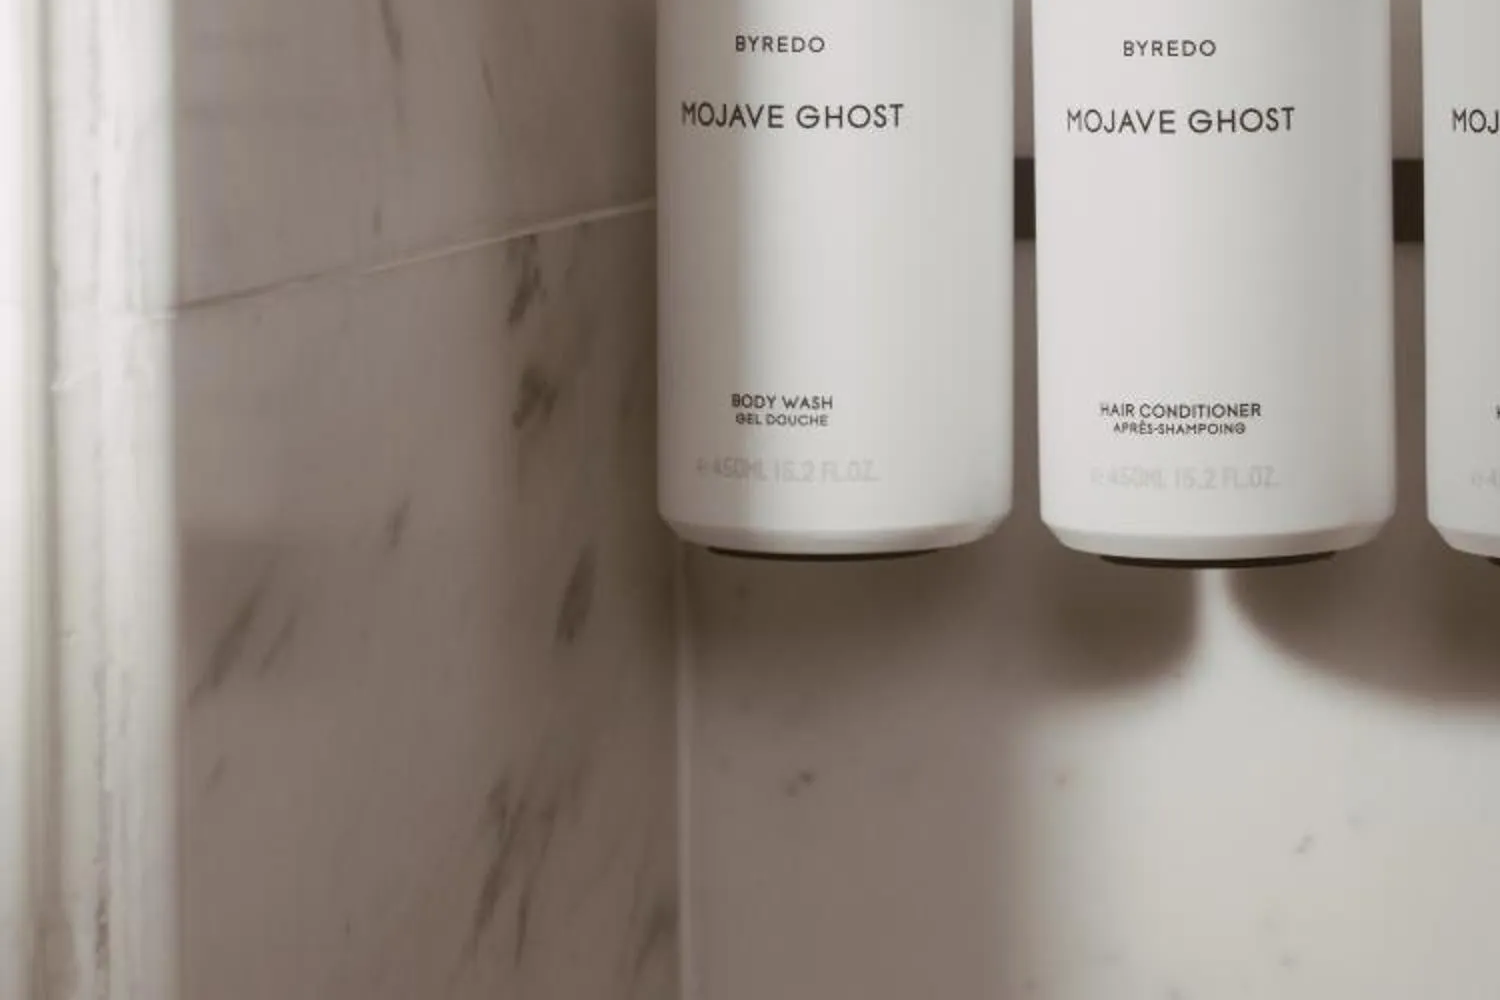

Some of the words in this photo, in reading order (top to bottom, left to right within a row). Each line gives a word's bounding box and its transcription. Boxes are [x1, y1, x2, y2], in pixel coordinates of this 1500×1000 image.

[735, 34, 826, 54] BYREDO
[1123, 39, 1217, 57] BYREDO
[681, 101, 785, 130] MOJAVE
[795, 103, 905, 130] GHOST
[1066, 108, 1177, 135] MOJAVE
[1187, 106, 1296, 135] GHOST
[731, 391, 777, 410] BODY
[781, 394, 834, 411] WASH
[735, 411, 763, 426] GEL
[764, 412, 829, 428] DOUCHE
[1100, 402, 1136, 419] HAIR
[1138, 402, 1262, 421] CONDITIONER
